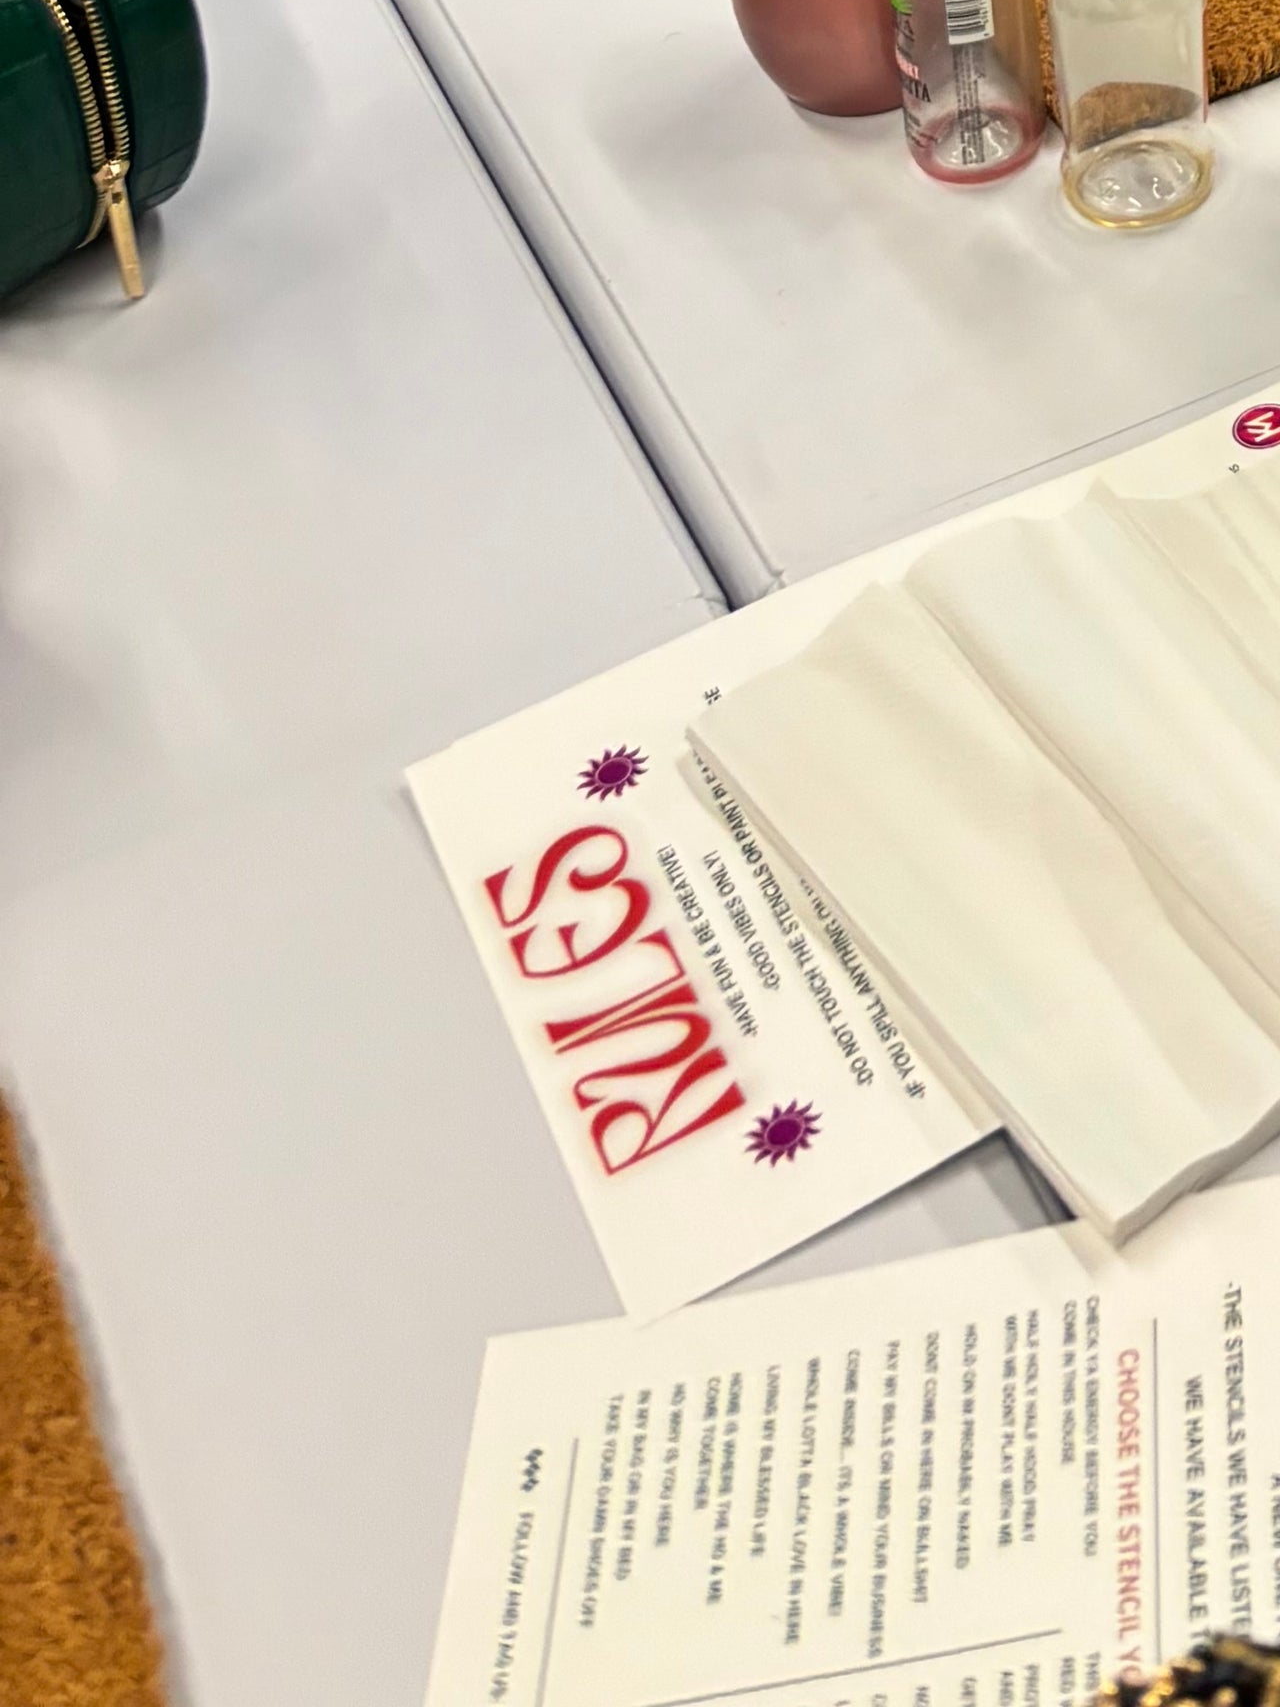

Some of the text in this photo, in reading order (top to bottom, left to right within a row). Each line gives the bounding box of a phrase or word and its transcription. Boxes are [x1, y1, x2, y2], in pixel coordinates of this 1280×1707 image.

[718, 799, 751, 842] PAINT
[740, 839, 762, 864] OR
[703, 850, 779, 990] -GOOD VIBES ONLY!
[752, 863, 798, 935] STENCILS
[657, 845, 757, 1036] -HAVE FUN & BE CREATIVE!
[787, 933, 813, 969] THE
[824, 918, 874, 995] ANYTHING
[486, 826, 745, 1176] RULES
[804, 966, 841, 1023] TOUCH
[866, 994, 897, 1042] SPILL
[831, 1022, 859, 1057] NOT
[849, 1056, 873, 1085] -DO
[887, 1041, 915, 1079] YOU
[1224, 1335, 1245, 1445] STENCILS
[1184, 1375, 1208, 1620] WE HAVE AVAILABLE
[1227, 1448, 1247, 1487] WE
[1116, 1348, 1141, 1681] CHOOSE THE STENCIL YO
[1228, 1491, 1249, 1558] HAVE
